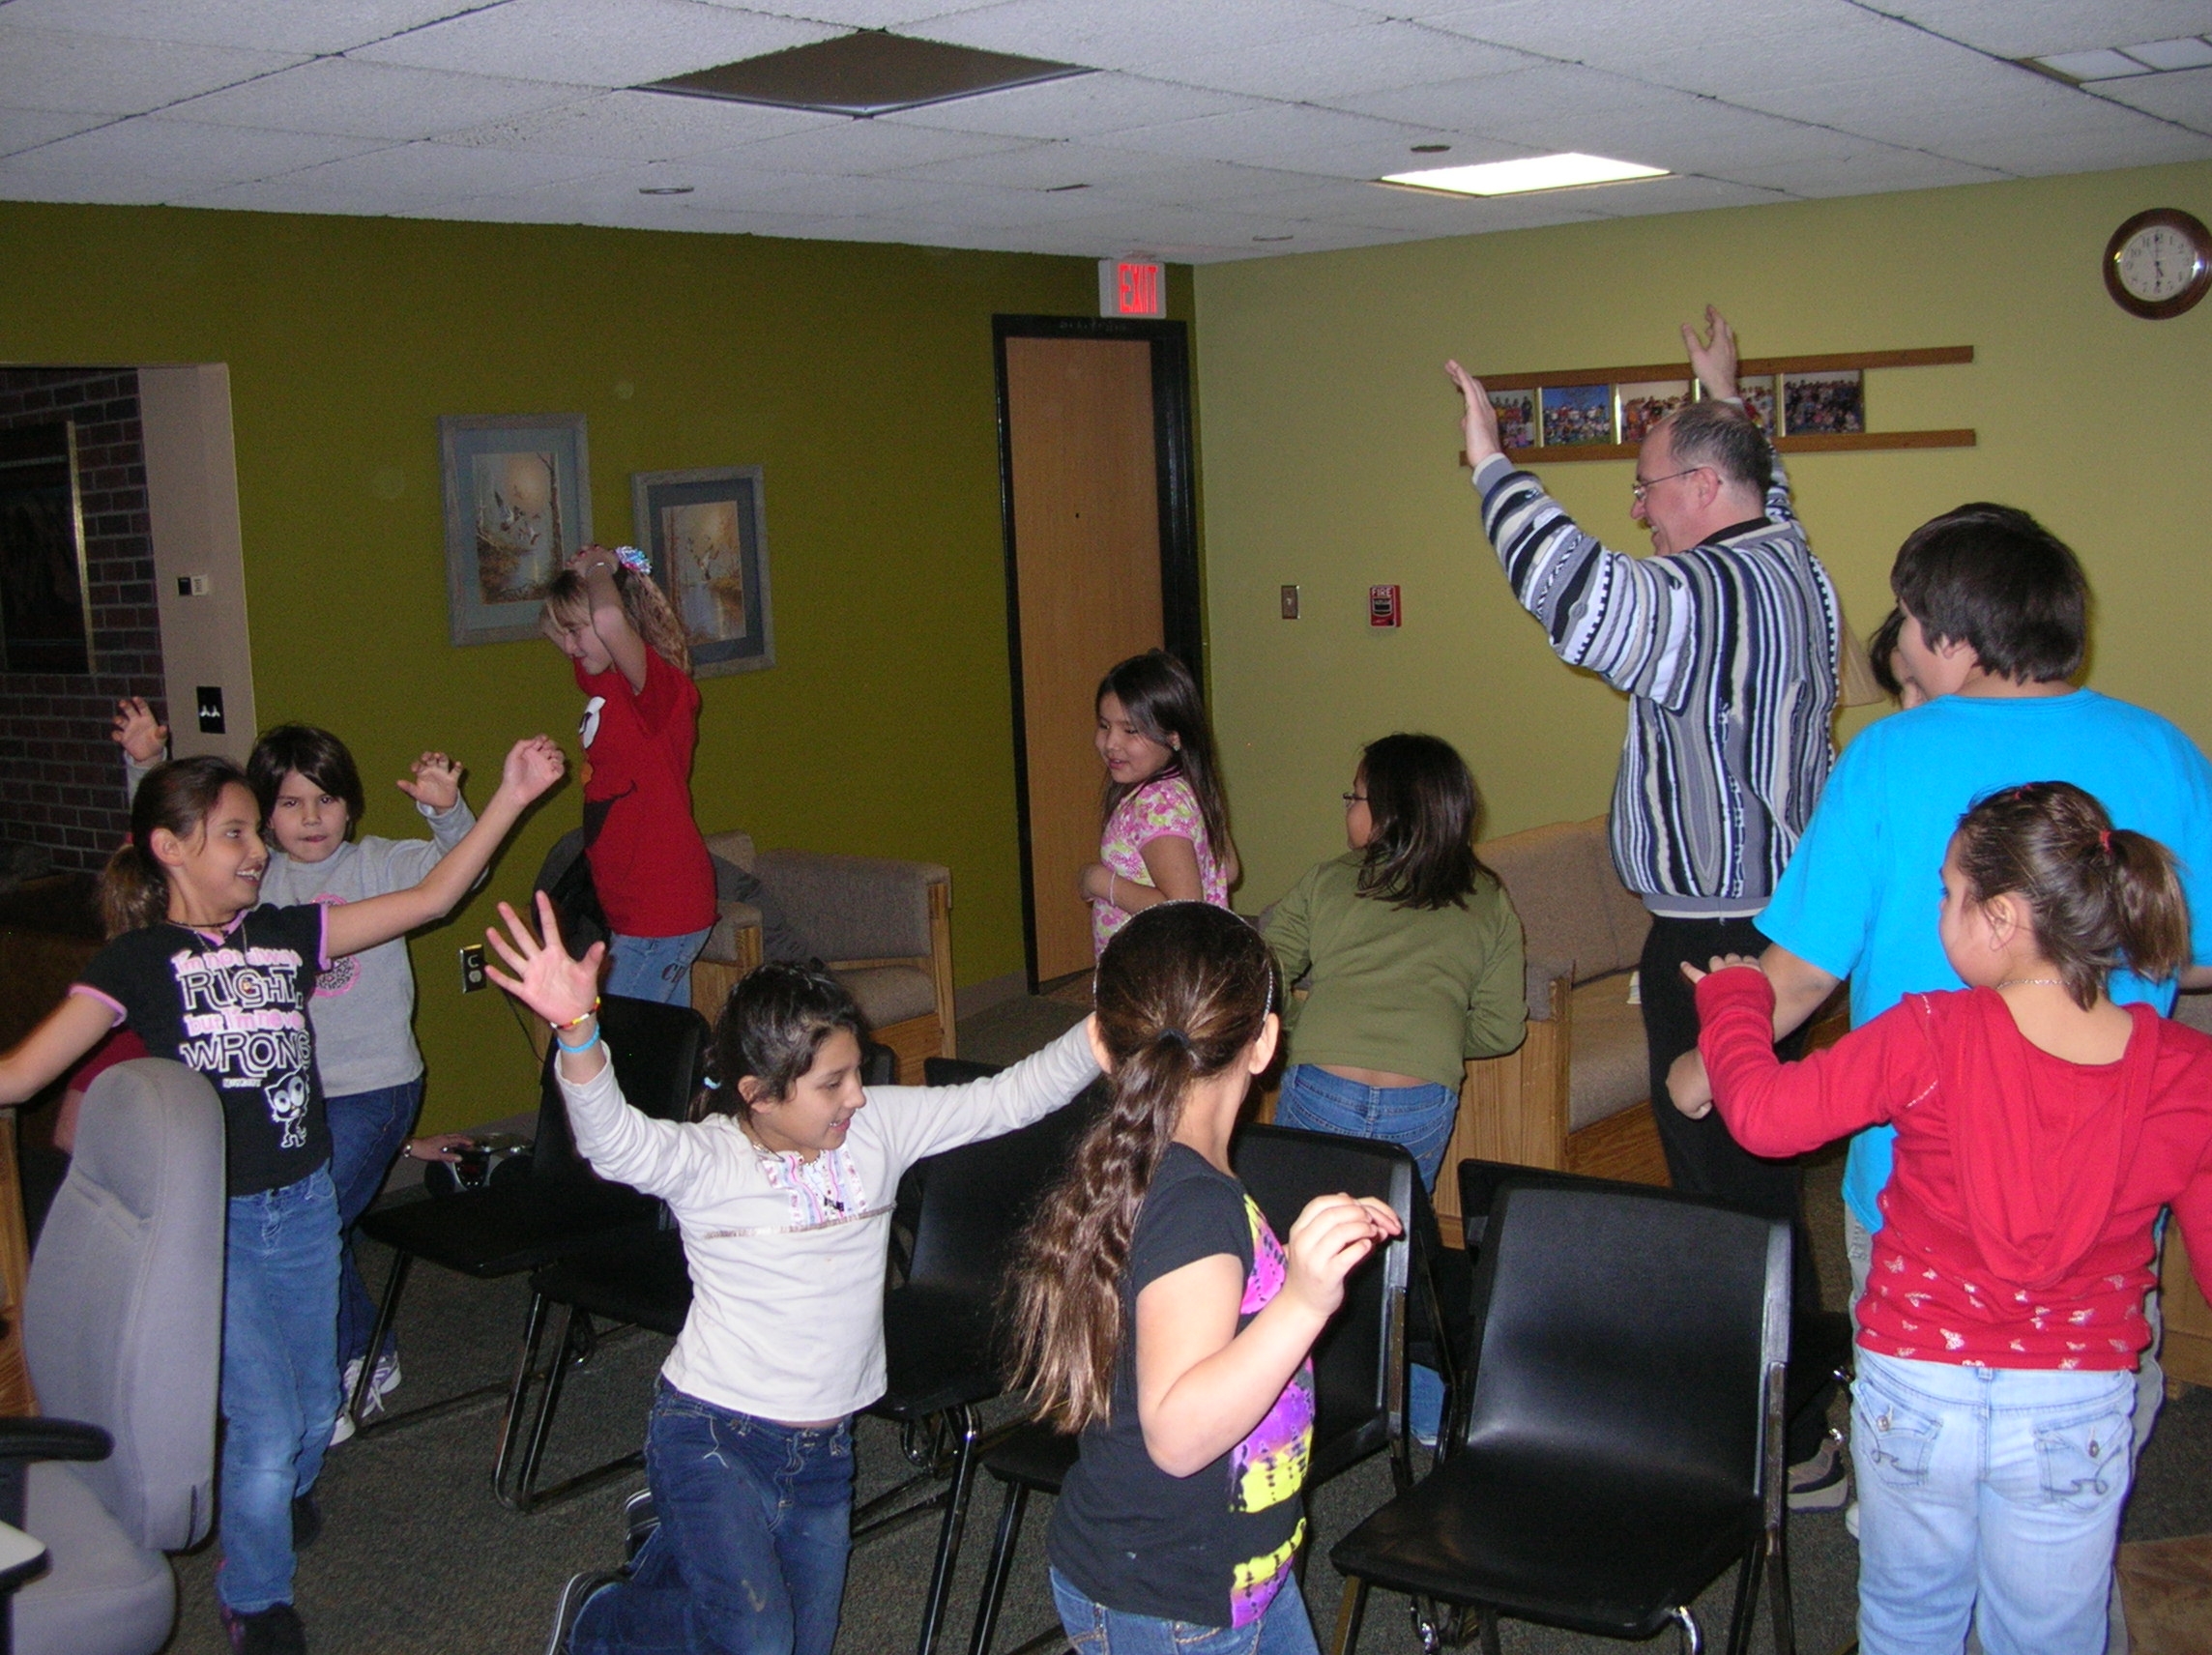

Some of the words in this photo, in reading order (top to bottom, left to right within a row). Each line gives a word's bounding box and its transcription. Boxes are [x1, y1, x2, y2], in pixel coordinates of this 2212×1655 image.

[1118, 263, 1157, 314] EXIT
[1372, 586, 1393, 598] FIRE
[184, 1013, 224, 1037] but
[179, 1030, 311, 1078] WRONG
